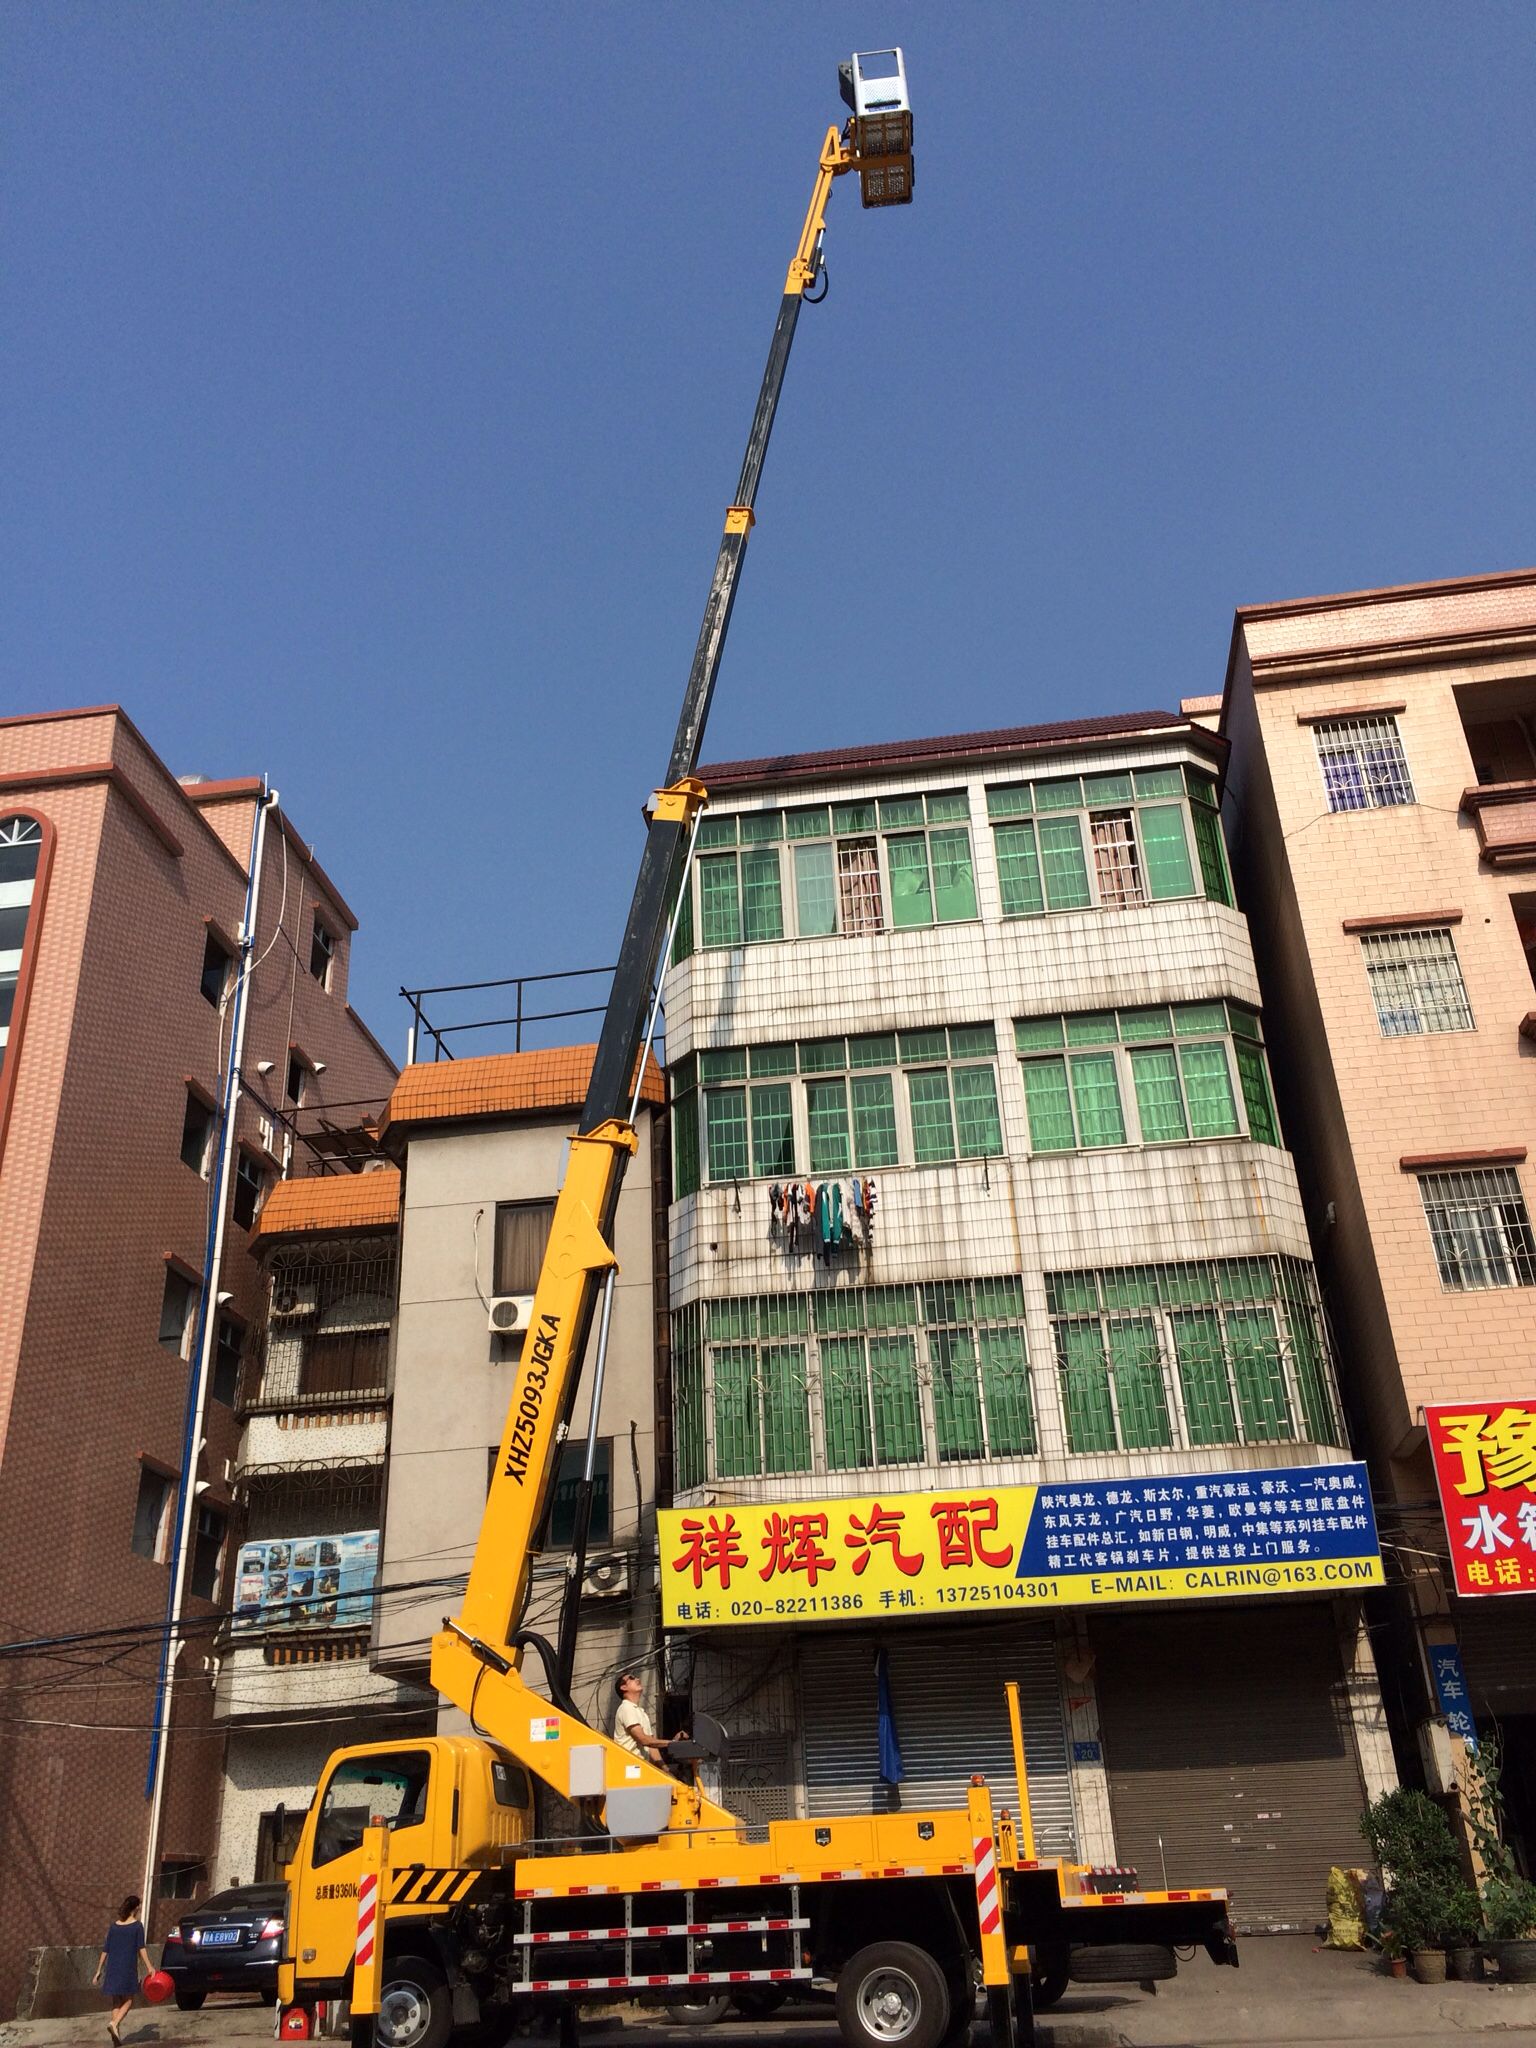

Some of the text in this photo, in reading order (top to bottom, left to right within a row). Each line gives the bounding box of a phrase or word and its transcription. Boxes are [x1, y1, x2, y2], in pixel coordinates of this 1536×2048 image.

[504, 1314, 561, 1486] XHZ5093JGKA
[672, 1497, 1014, 1590] 祥辉汽配
[731, 1594, 864, 1616] 020-82211386
[936, 1582, 1059, 1603] 13725104301
[1185, 1562, 1374, 1588] CALRIN@163.COM
